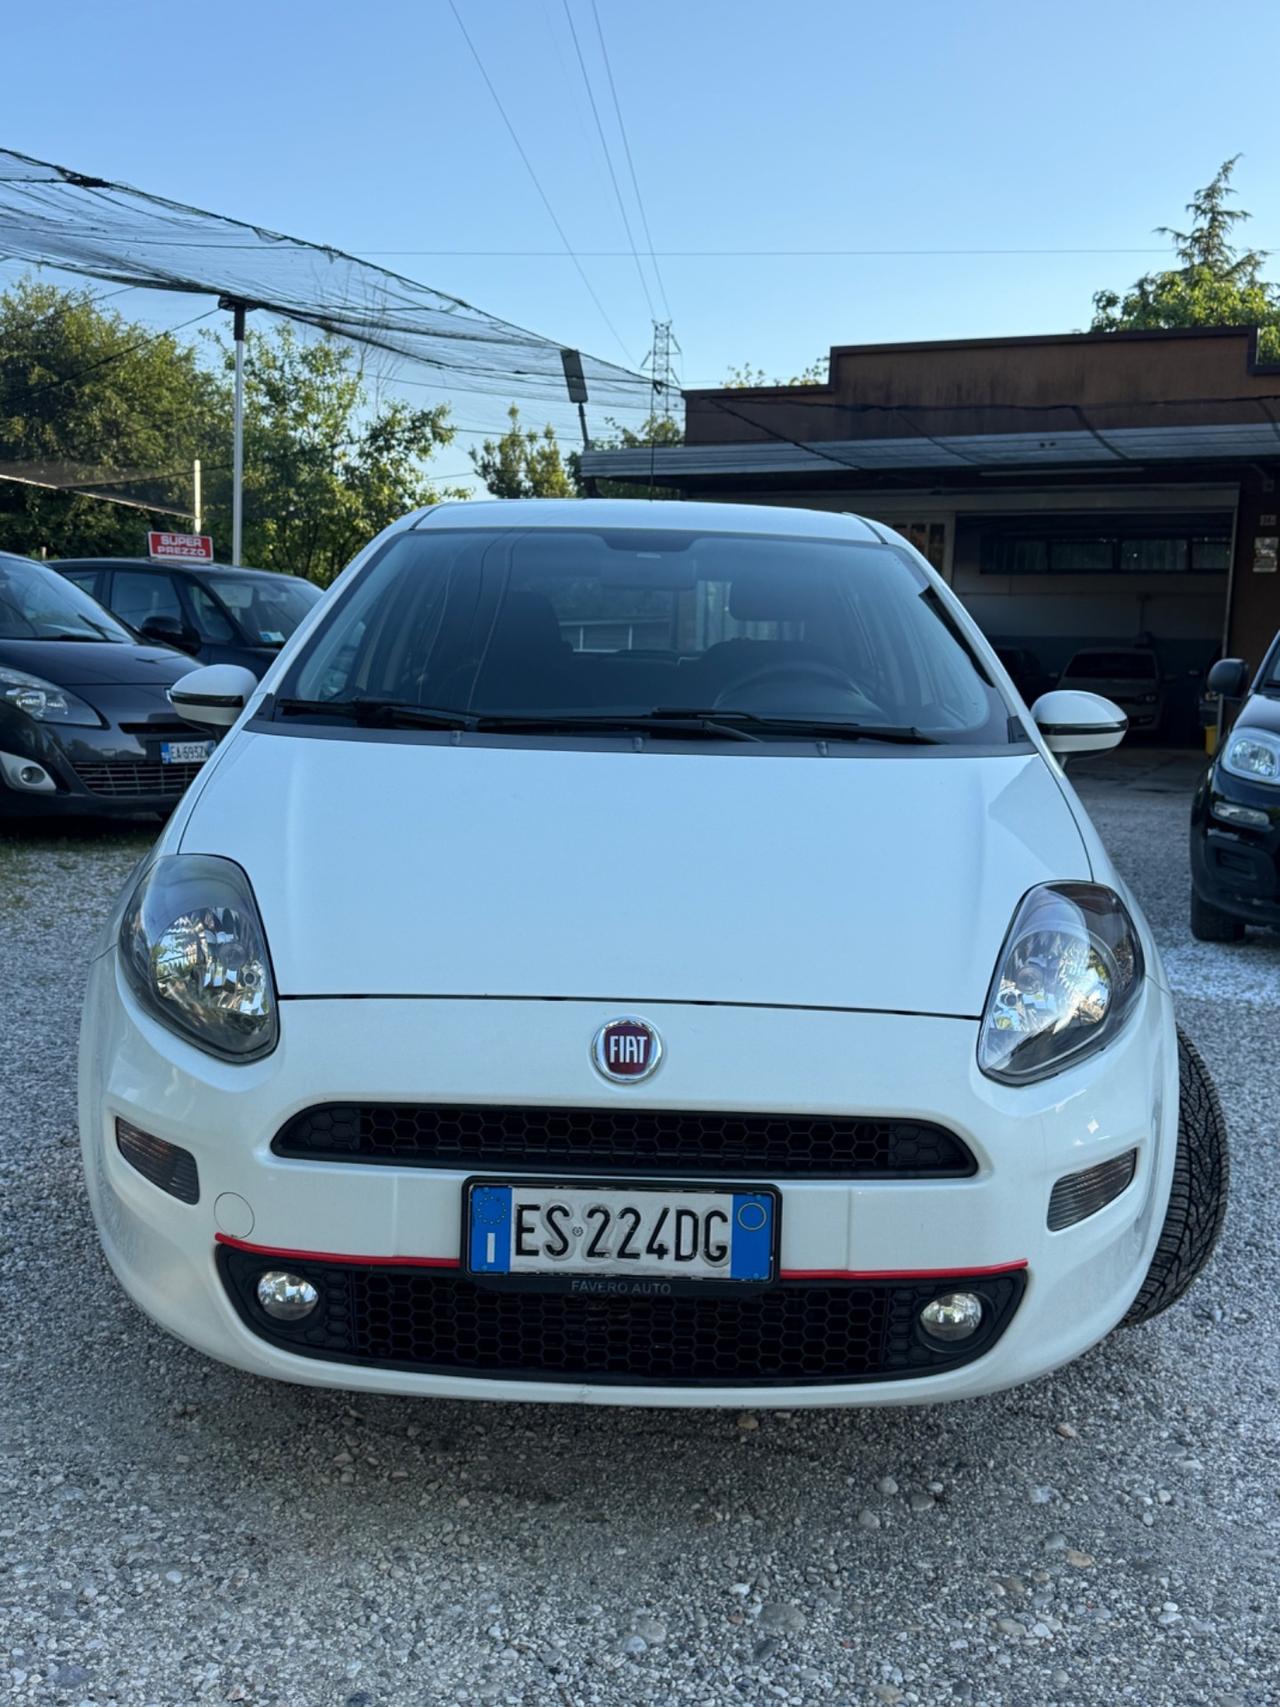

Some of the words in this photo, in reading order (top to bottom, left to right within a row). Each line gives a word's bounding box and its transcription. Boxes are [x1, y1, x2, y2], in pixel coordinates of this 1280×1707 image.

[160, 535, 202, 547] SUPER
[157, 545, 206, 556] PREZZO
[609, 1035, 648, 1064] FIAT
[570, 1280, 628, 1295] FAVERO
[631, 1282, 672, 1296] AUTO
